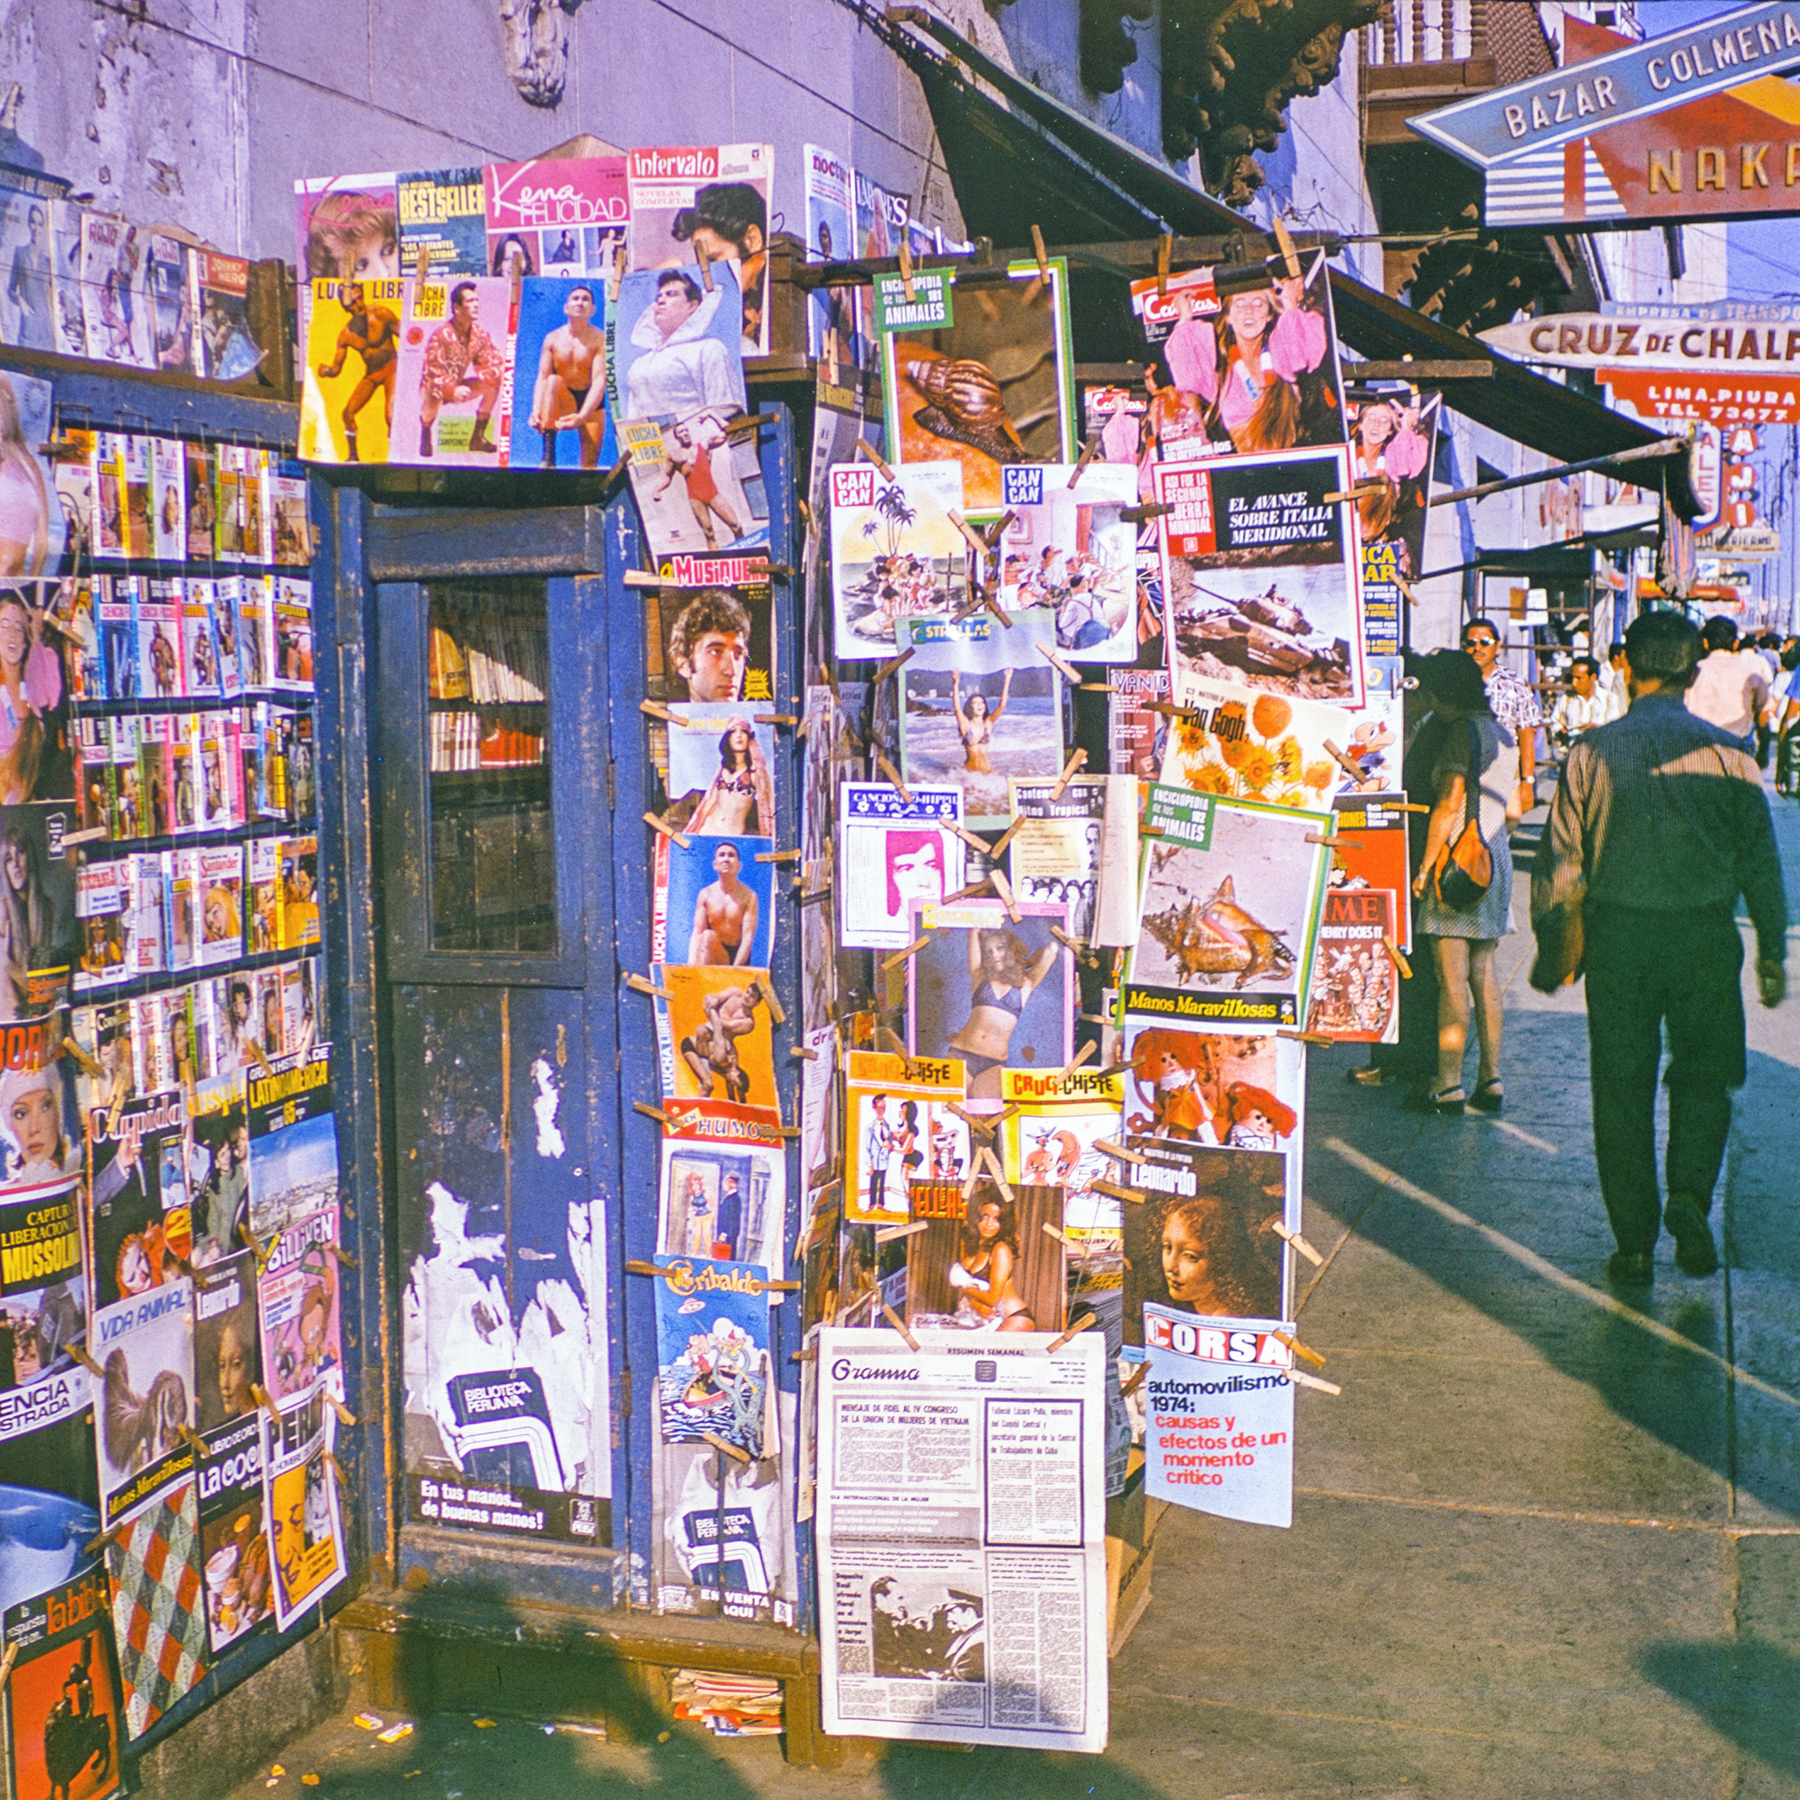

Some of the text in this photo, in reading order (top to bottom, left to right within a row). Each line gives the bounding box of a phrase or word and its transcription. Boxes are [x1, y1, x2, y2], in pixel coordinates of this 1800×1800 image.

[1504, 11, 1800, 138] BAZAR COLMENA
[634, 151, 715, 177] intervalo
[491, 160, 584, 217] Kena
[636, 190, 681, 198] NOVELAS
[520, 197, 627, 225] FELICIDAD
[413, 301, 445, 317] LIBRE
[885, 303, 945, 326] ANIMALES
[1616, 305, 1690, 317] EMPRESA
[1700, 308, 1719, 319] DE
[1529, 323, 1641, 356] CRUZ
[1645, 333, 1674, 353] DE
[606, 320, 618, 402] LUCHA LIBRE
[502, 333, 517, 415] LUCHA LIBRE
[1655, 402, 1788, 421] TEL 73477
[627, 426, 658, 442] LUCHA
[632, 446, 667, 462] LIBRE
[836, 472, 871, 490] CAN
[1006, 469, 1041, 487] CAN
[1181, 473, 1195, 487] FUE
[1197, 472, 1208, 485] LA
[837, 489, 870, 506] CAN
[1008, 485, 1041, 503] CAN
[1165, 486, 1209, 502] SEGUNDA
[1228, 491, 1308, 513] EL AVANCE
[1168, 518, 1211, 535] MUNDIAL
[1230, 506, 1333, 528] SOBRE ITALIA
[1231, 523, 1328, 544] MERIDIONAL
[1209, 707, 1246, 743] Gogh
[1154, 789, 1209, 811] ENCICLOPEDIA
[1049, 804, 1089, 817] Tropical
[1151, 815, 1206, 842] ANIMALES
[656, 886, 668, 916] LIBRE
[1347, 925, 1371, 939] DOES
[1372, 925, 1384, 939] IT
[1128, 991, 1278, 1018] Manos Maravillosas
[313, 1046, 329, 1061] DE
[659, 1011, 674, 1091] LUCHA LIBRE
[250, 1060, 329, 1109] LATINOAMERICA
[1130, 1162, 1197, 1197] Leonardo
[1, 1220, 70, 1247] LIBERACION
[101, 1288, 186, 1341] VIDA ANIMAL
[1147, 1314, 1290, 1366] CORSA
[947, 1347, 1026, 1357] RESUMEN SEMANAL
[831, 1358, 920, 1382] Granma
[464, 1381, 532, 1401] BIBLIOTECA
[1149, 1375, 1291, 1395] automovilismo
[467, 1395, 525, 1414] PERUANA
[841, 1404, 870, 1413] MENSAJE
[872, 1404, 881, 1412] DE
[884, 1404, 900, 1413] FIDEL
[903, 1405, 911, 1413] AL
[923, 1405, 959, 1414] CONGRESO
[1152, 1396, 1196, 1413] 1974:
[841, 1415, 969, 1425] DE LA UNION DE MUJERES DE VIETNAM
[1155, 1415, 1236, 1431] causas y
[1158, 1431, 1287, 1450] efectos de un
[1163, 1452, 1254, 1467] momento
[108, 1454, 194, 1518] Manos Maravillosas
[420, 1480, 438, 1496] En
[442, 1484, 464, 1501] tus
[421, 1500, 544, 1531] de buenas manos!
[701, 1588, 720, 1602] EN
[724, 1591, 770, 1608] VENTA
